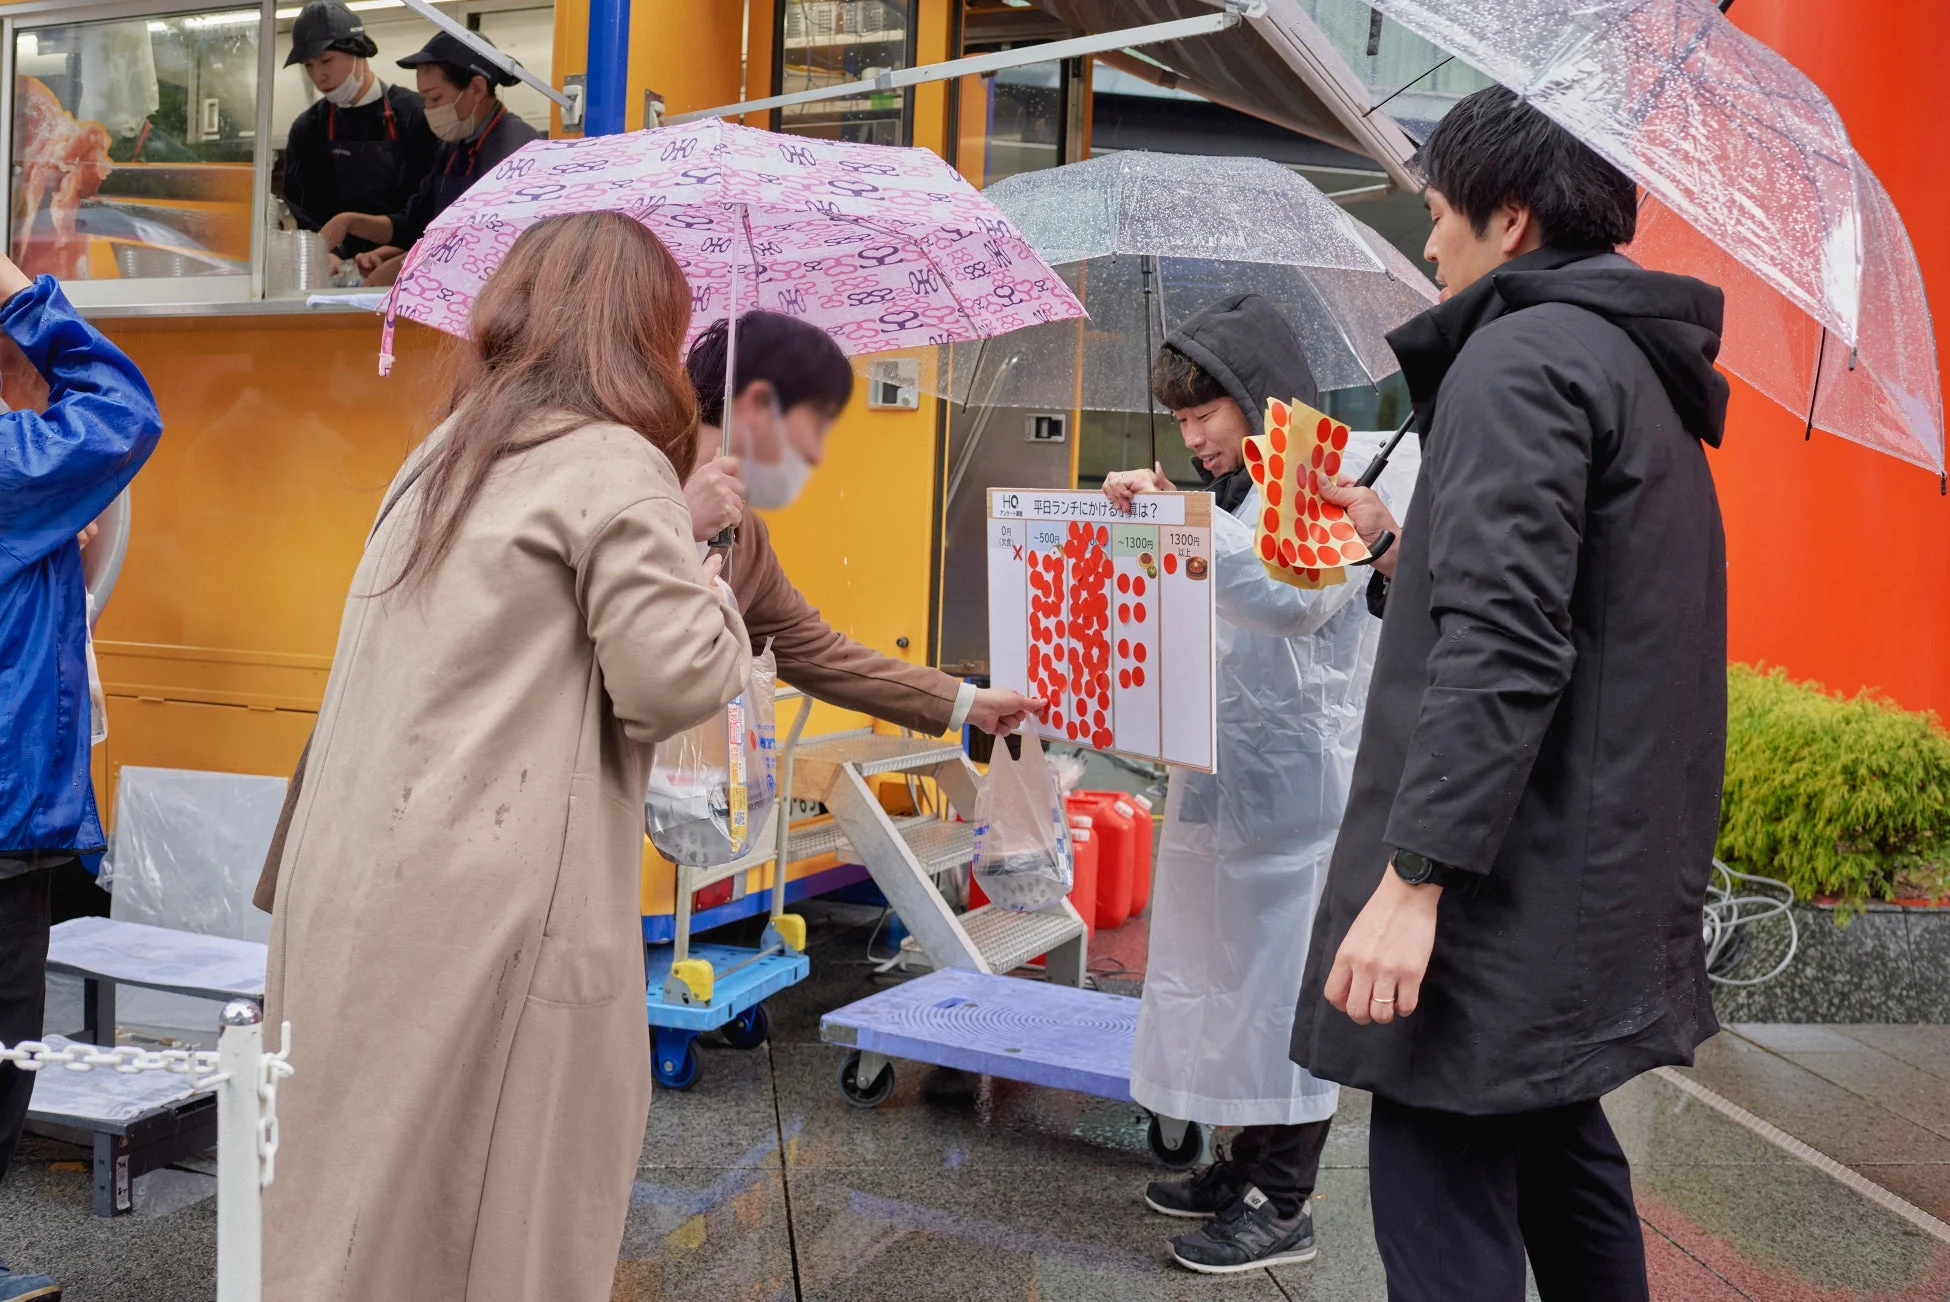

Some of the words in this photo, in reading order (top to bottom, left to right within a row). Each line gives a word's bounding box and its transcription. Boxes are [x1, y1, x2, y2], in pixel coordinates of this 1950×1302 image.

[1033, 499, 1158, 519] 平日ランチにかける算は？
[1170, 533, 1201, 547] 1300円
[1178, 548, 1192, 558] 以上
